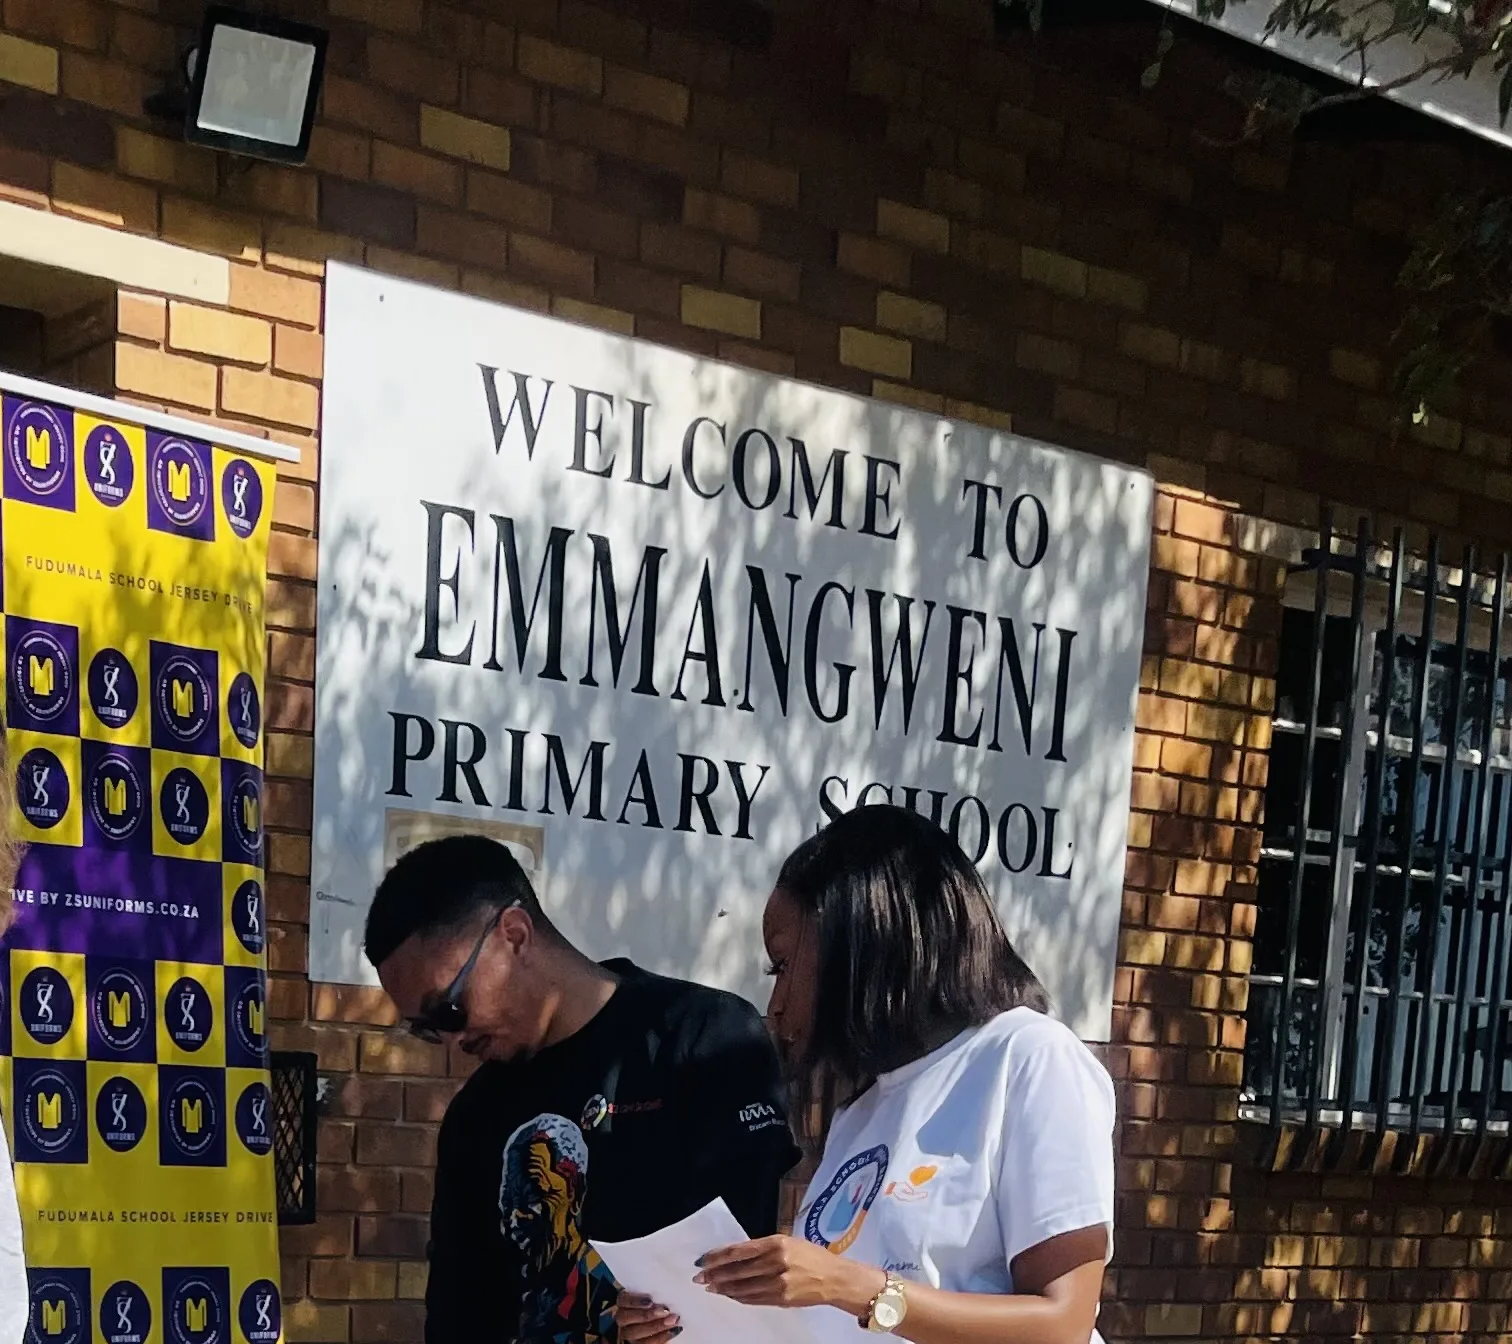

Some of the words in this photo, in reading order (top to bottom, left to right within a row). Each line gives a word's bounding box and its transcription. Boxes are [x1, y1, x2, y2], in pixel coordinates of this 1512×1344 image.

[474, 361, 903, 542] WELCOME
[962, 479, 1051, 571] TO
[26, 556, 102, 582] FUDUMALA
[109, 572, 164, 594] SCHOOL
[170, 582, 218, 603] JERSEY
[414, 498, 1079, 763] EMMANGWENI
[384, 711, 771, 841] PRIMARY
[816, 776, 1075, 880] SOOL
[40, 891, 59, 905] BY
[65, 893, 199, 918] ZSUNIFORMS.CO.ZA
[37, 1210, 115, 1223] FUDUMALA
[121, 1210, 177, 1223] SCHOOL
[183, 1211, 230, 1224] JERSEY
[235, 1211, 273, 1224] DRIVE
